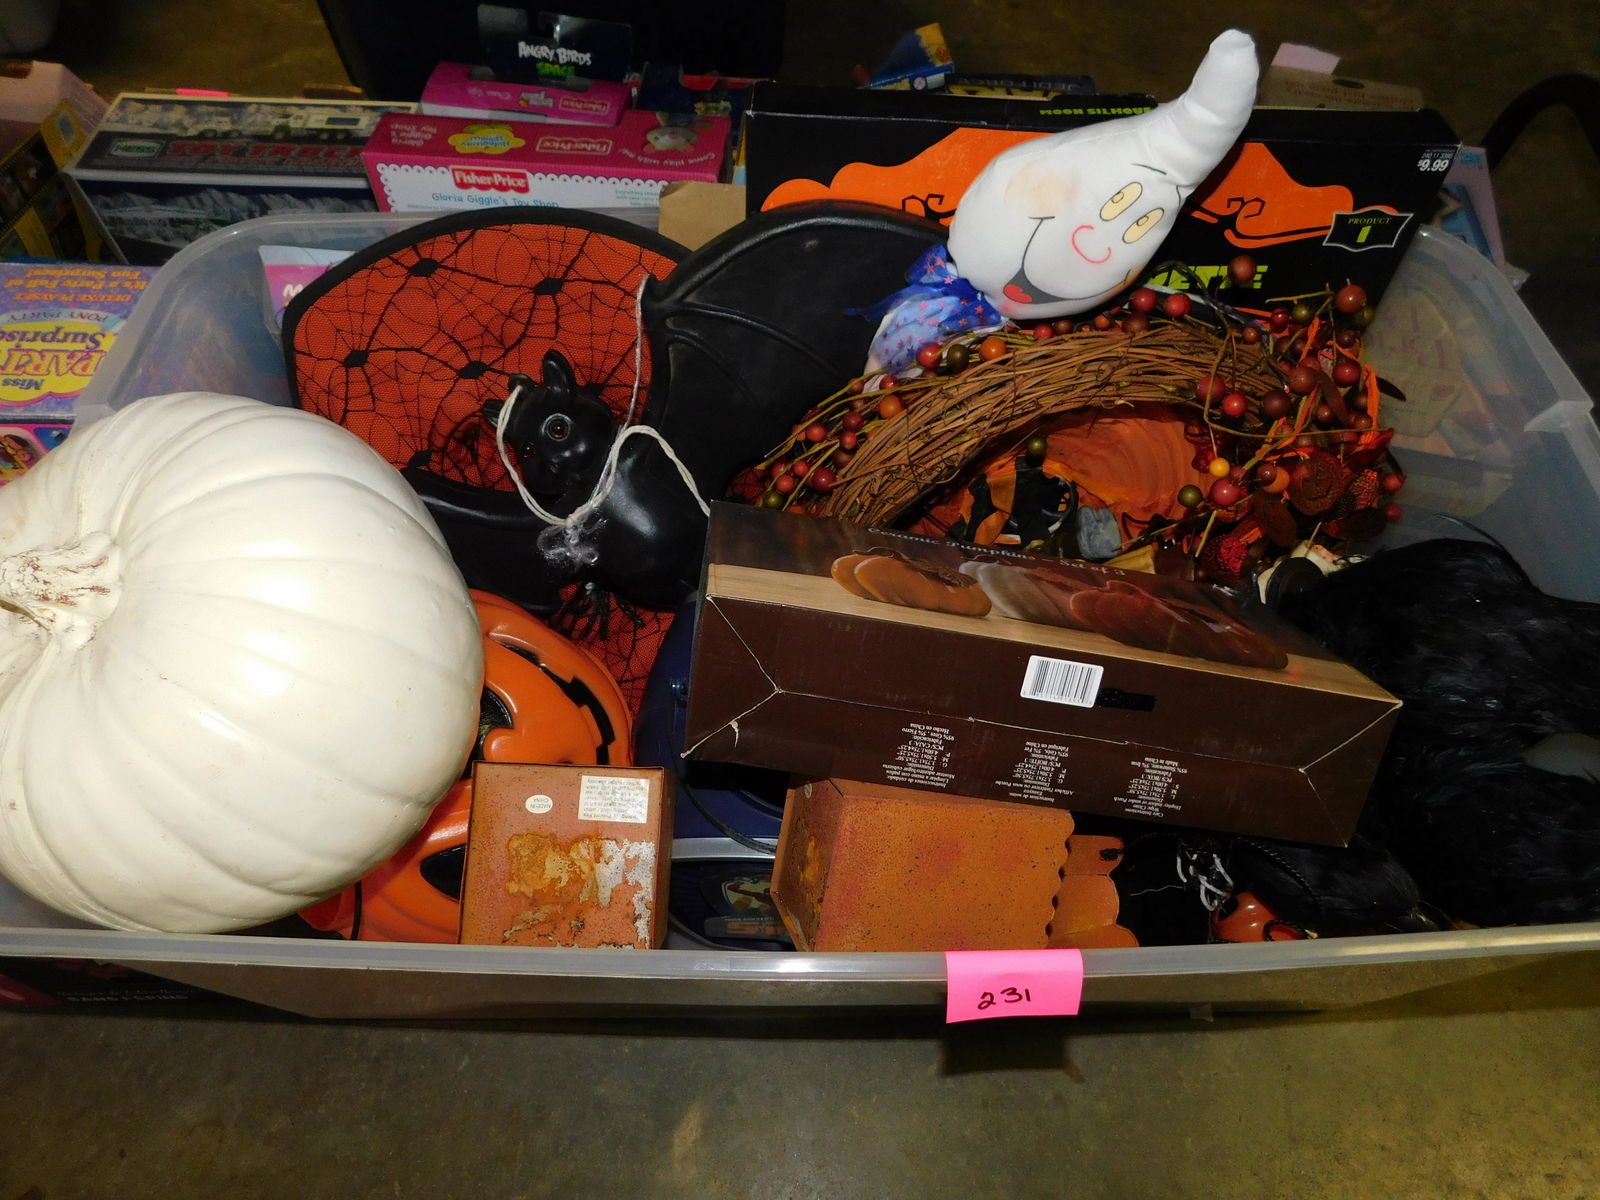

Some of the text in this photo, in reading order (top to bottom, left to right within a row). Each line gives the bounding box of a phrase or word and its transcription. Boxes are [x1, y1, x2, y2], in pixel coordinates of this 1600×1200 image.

[518, 41, 592, 66] ANGRY BIRDS
[542, 140, 608, 152] Fisher-Price
[637, 156, 660, 165] with
[688, 152, 716, 164] Come
[1417, 159, 1449, 172] $9.99
[455, 171, 526, 188] Fisher-Price
[432, 193, 464, 202] Gloria
[467, 195, 508, 206] Giggle's
[513, 198, 529, 206] Toy
[1356, 226, 1372, 243] 1
[3, 280, 24, 288] of
[25, 280, 59, 289] Full
[62, 279, 105, 290] Party
[7, 312, 108, 322] PONY PARTY
[0, 348, 107, 377] PART
[0, 378, 46, 390] Miss
[978, 987, 1030, 1010] 231
